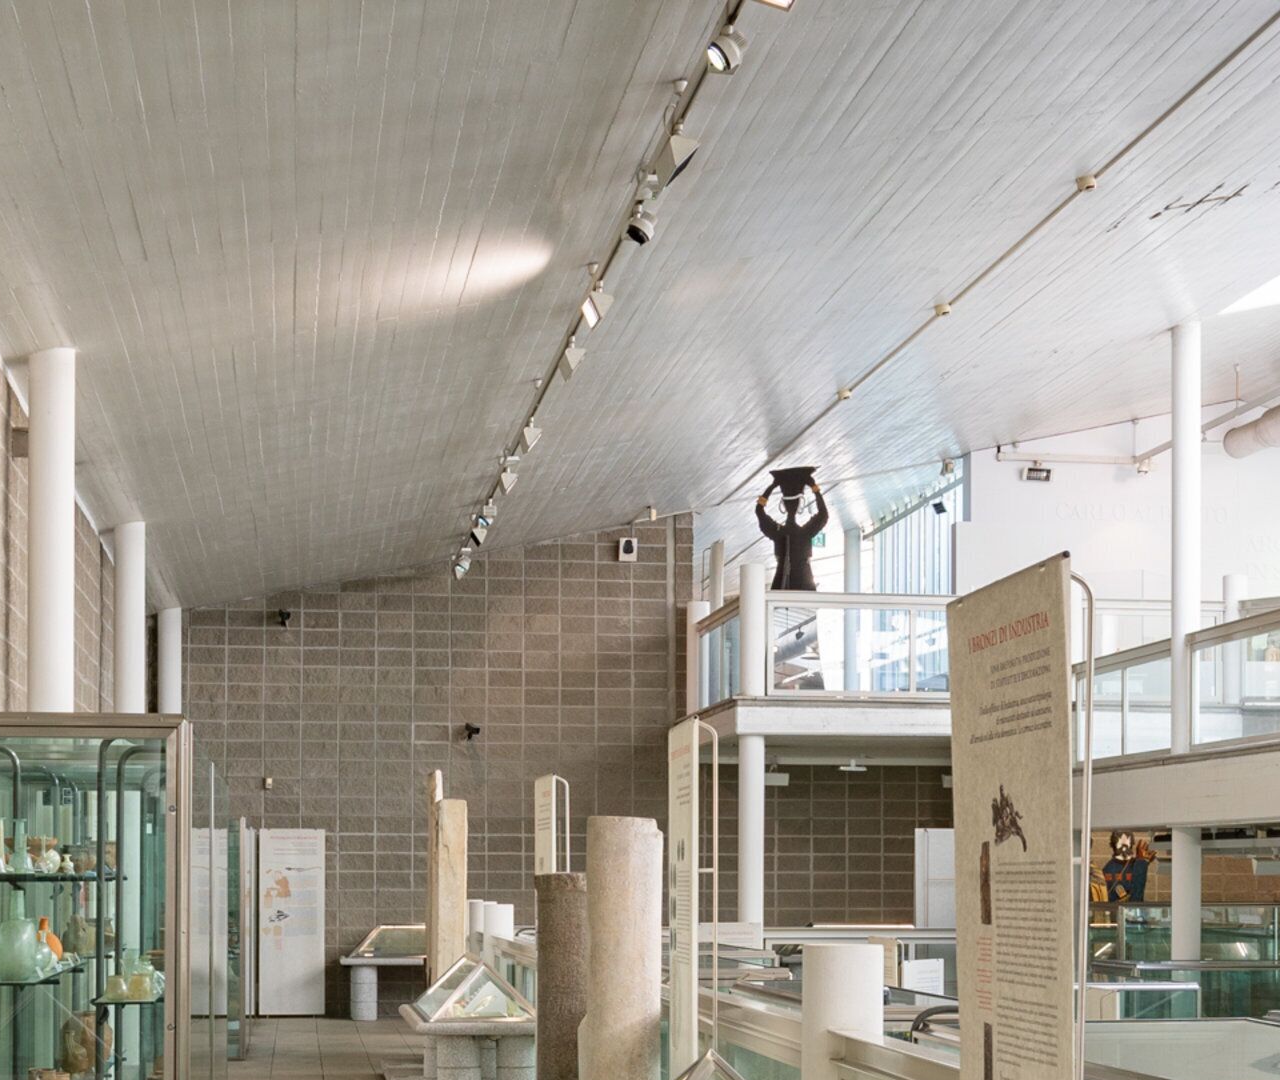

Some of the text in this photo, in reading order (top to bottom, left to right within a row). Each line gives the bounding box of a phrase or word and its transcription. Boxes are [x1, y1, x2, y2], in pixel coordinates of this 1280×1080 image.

[972, 629, 998, 653] BRONZI
[999, 624, 1008, 643] DI
[1009, 611, 1050, 641] INDUSTRIA
